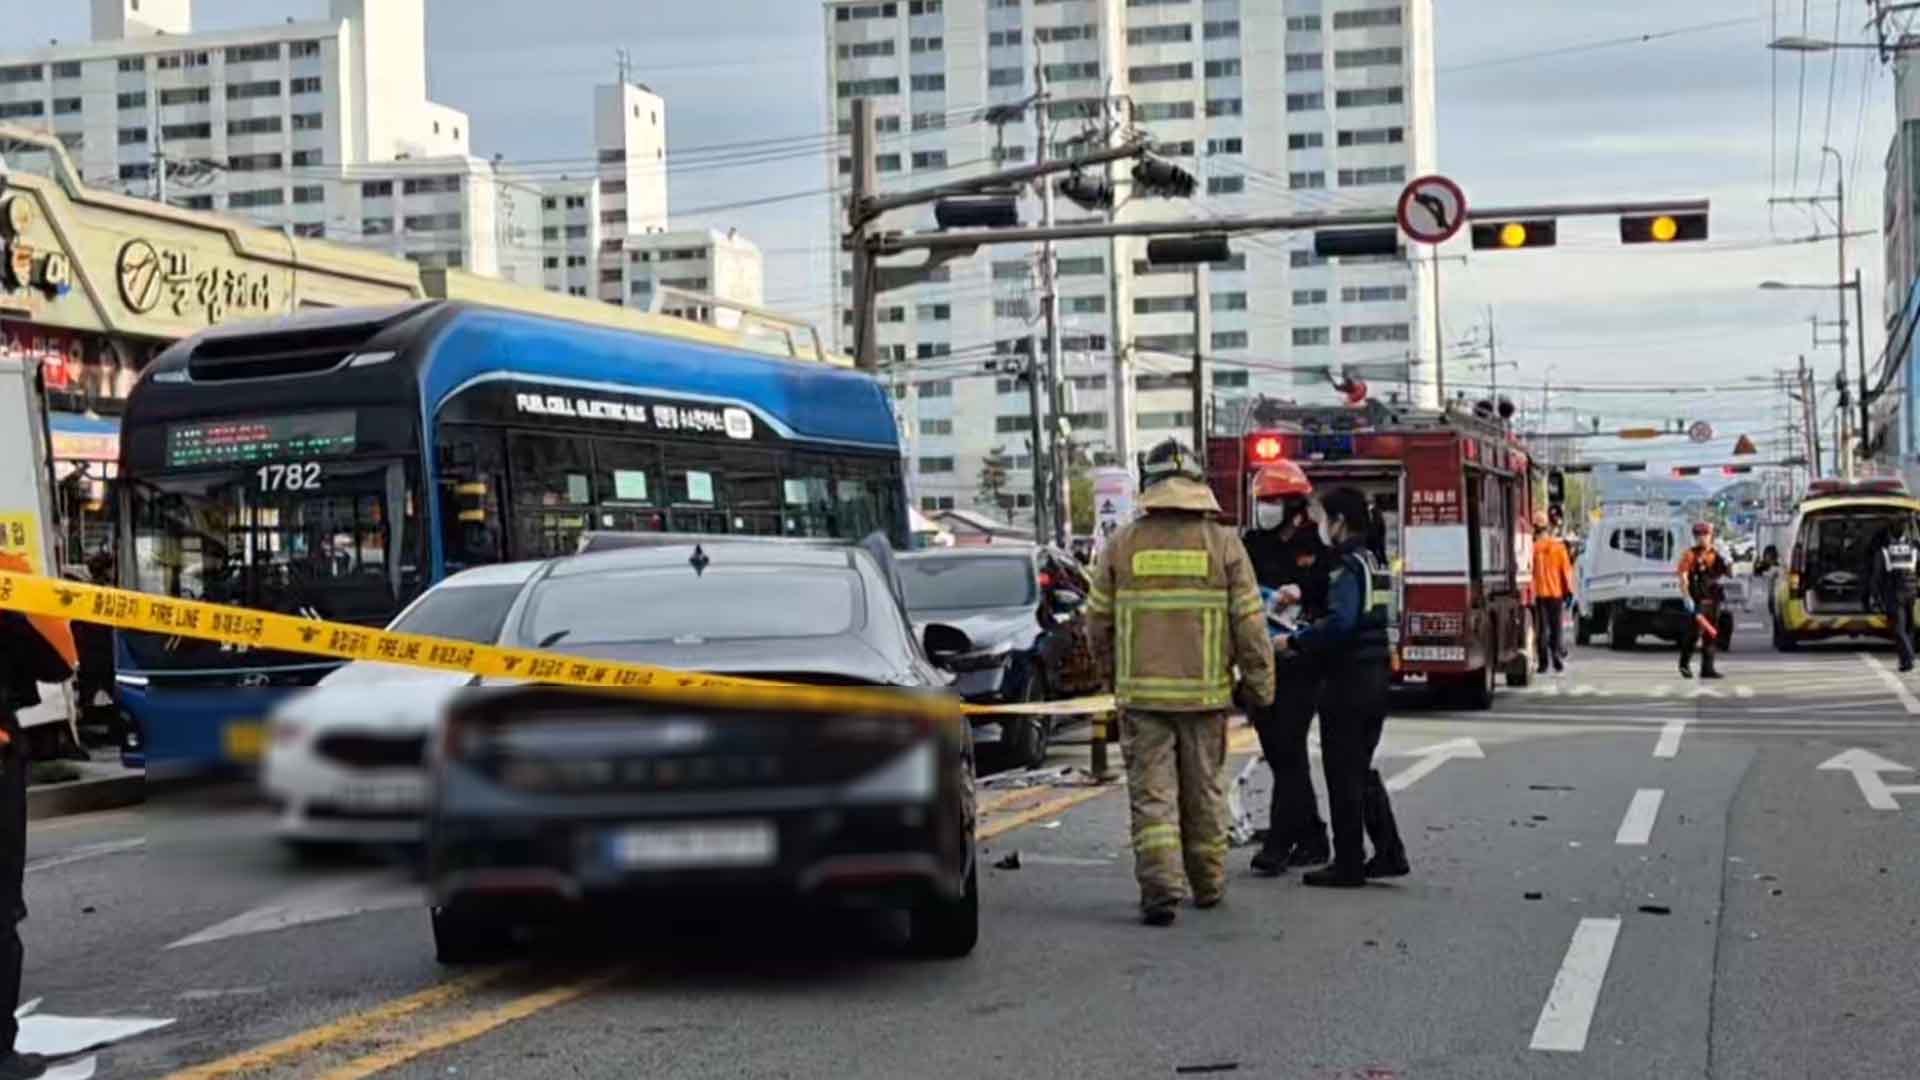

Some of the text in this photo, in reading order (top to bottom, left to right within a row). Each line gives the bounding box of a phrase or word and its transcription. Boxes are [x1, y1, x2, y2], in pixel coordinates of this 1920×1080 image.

[256, 461, 322, 492] 1782
[150, 602, 174, 627] FIRE
[175, 606, 201, 629] LINE
